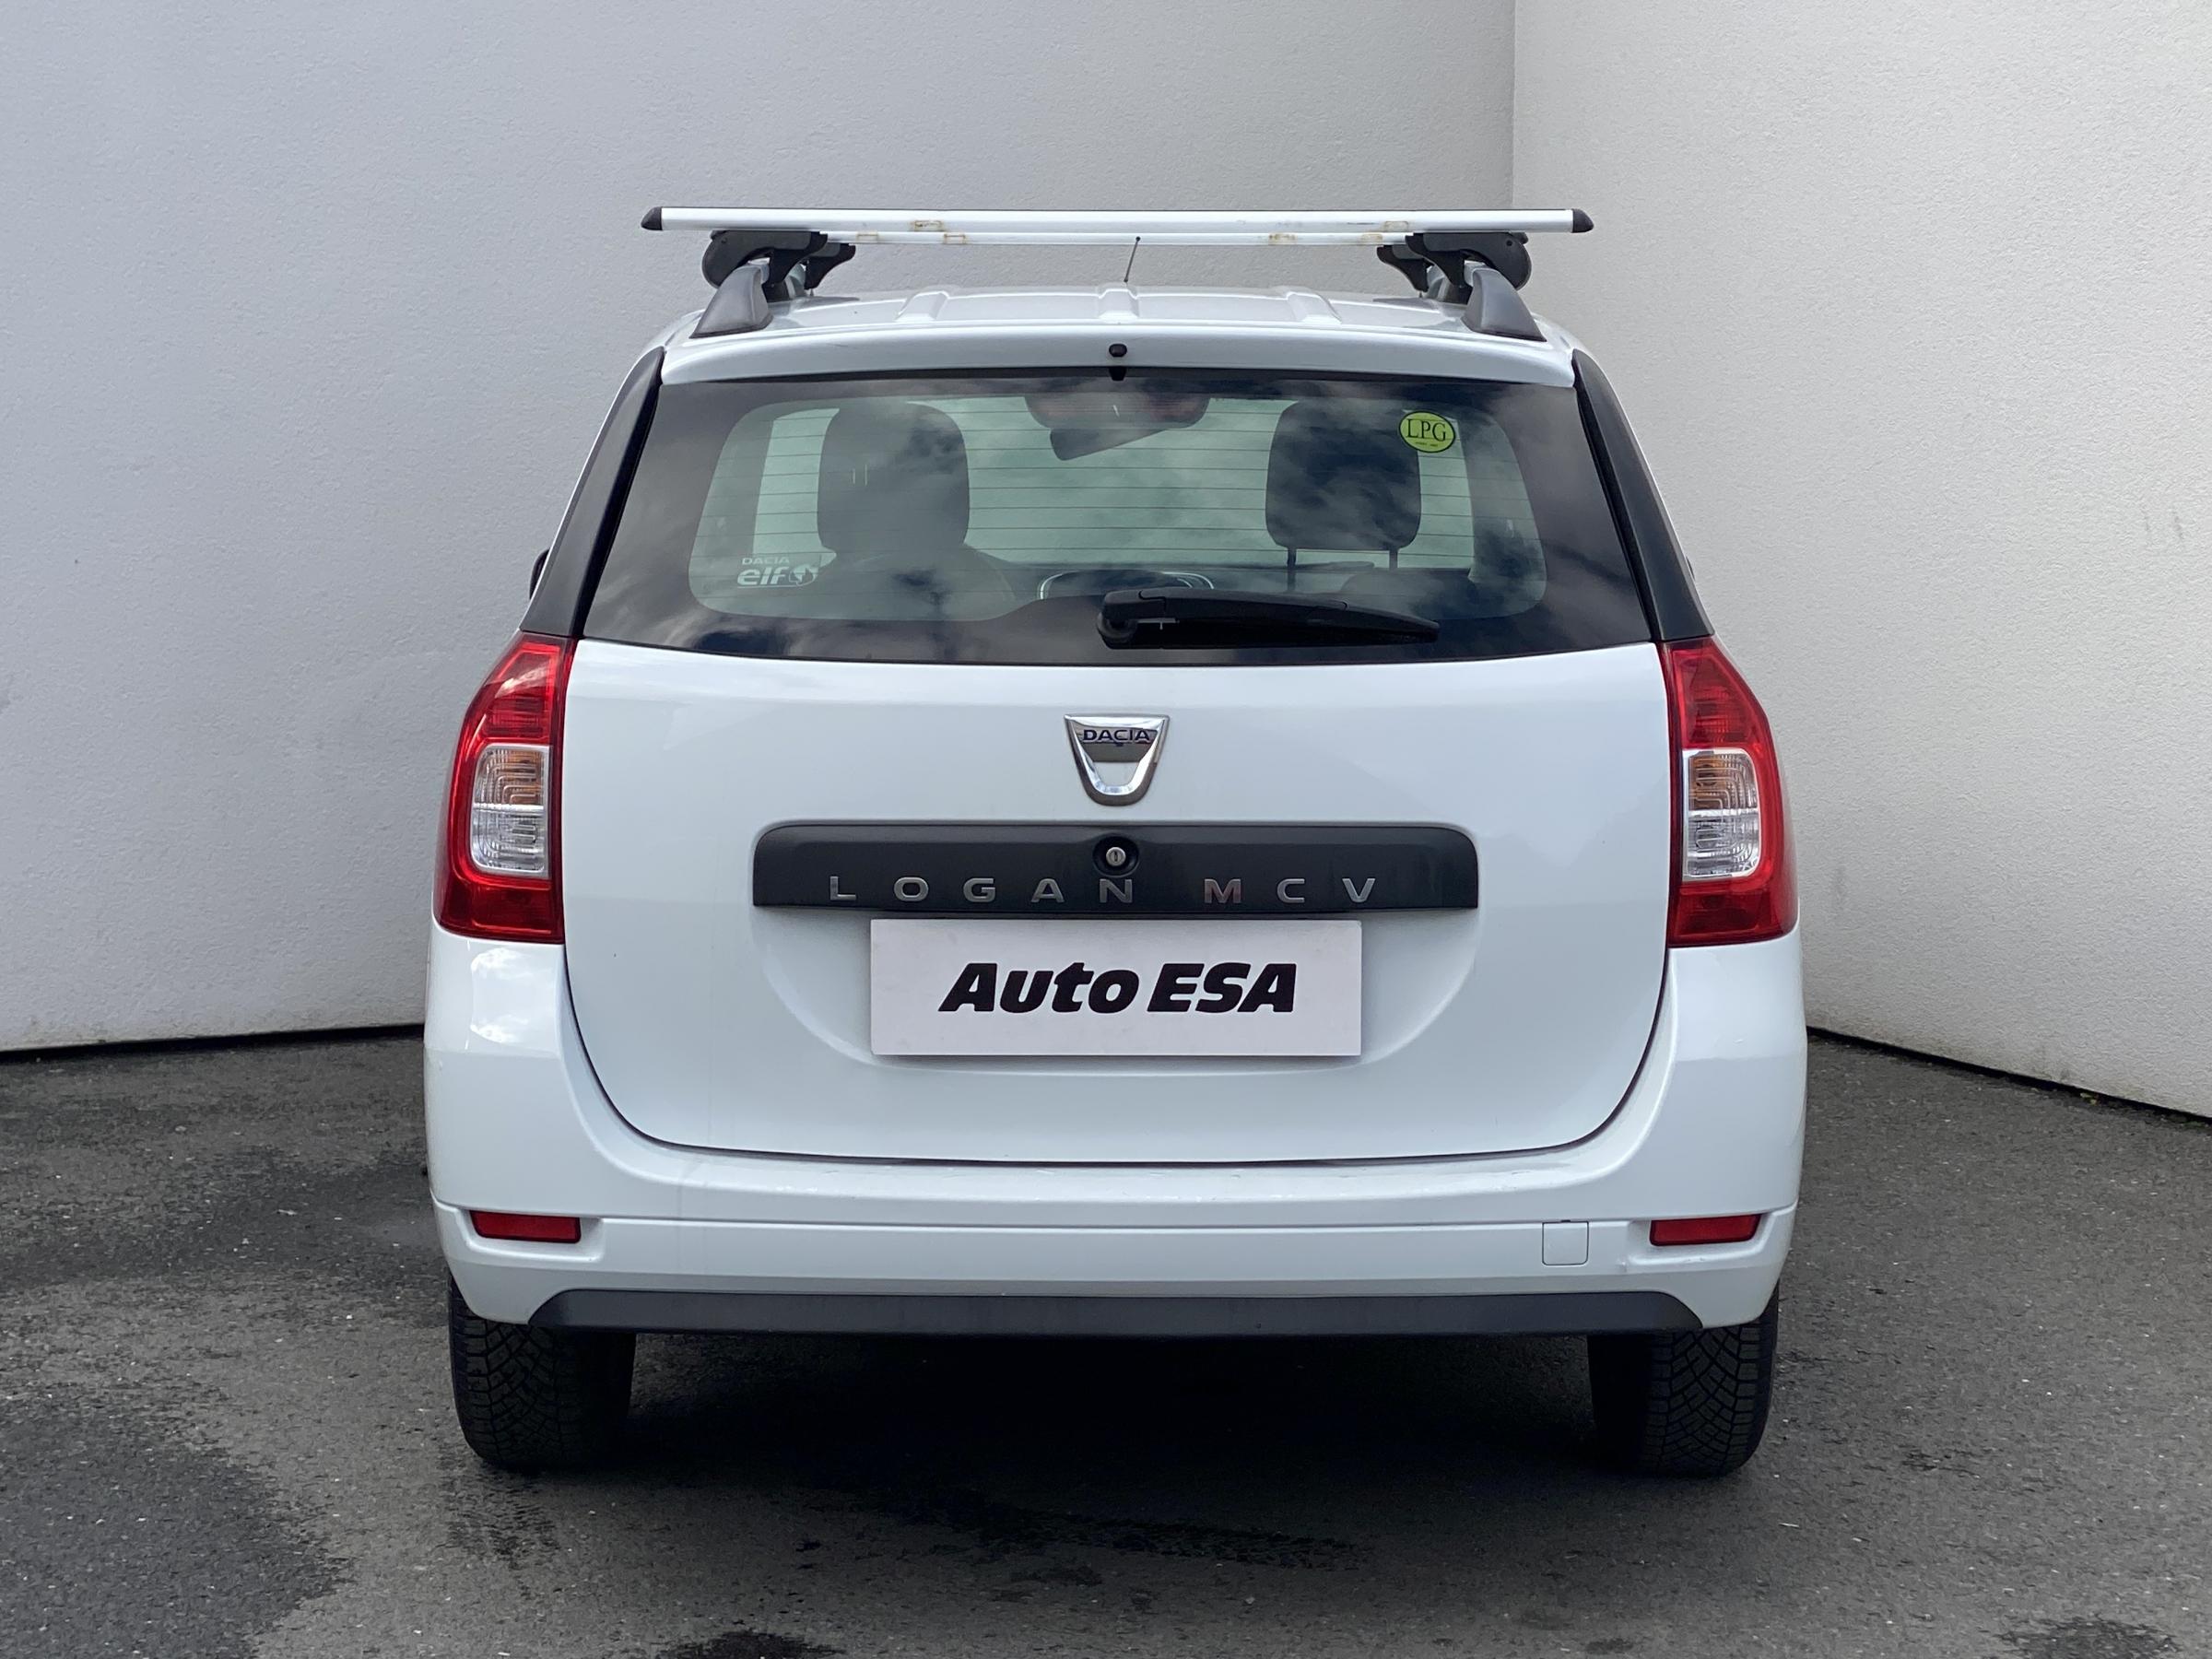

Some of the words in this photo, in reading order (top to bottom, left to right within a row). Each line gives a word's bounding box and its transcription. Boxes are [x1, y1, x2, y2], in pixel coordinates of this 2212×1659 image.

[1406, 418, 1446, 441] LPG
[741, 557, 790, 565] DACIA
[737, 567, 789, 585] elf
[1083, 729, 1150, 741] DACIA
[830, 876, 1133, 903] LOGAN
[1204, 877, 1376, 904] MCV
[937, 962, 1140, 1014] Auto
[1146, 962, 1297, 1013] ESA
